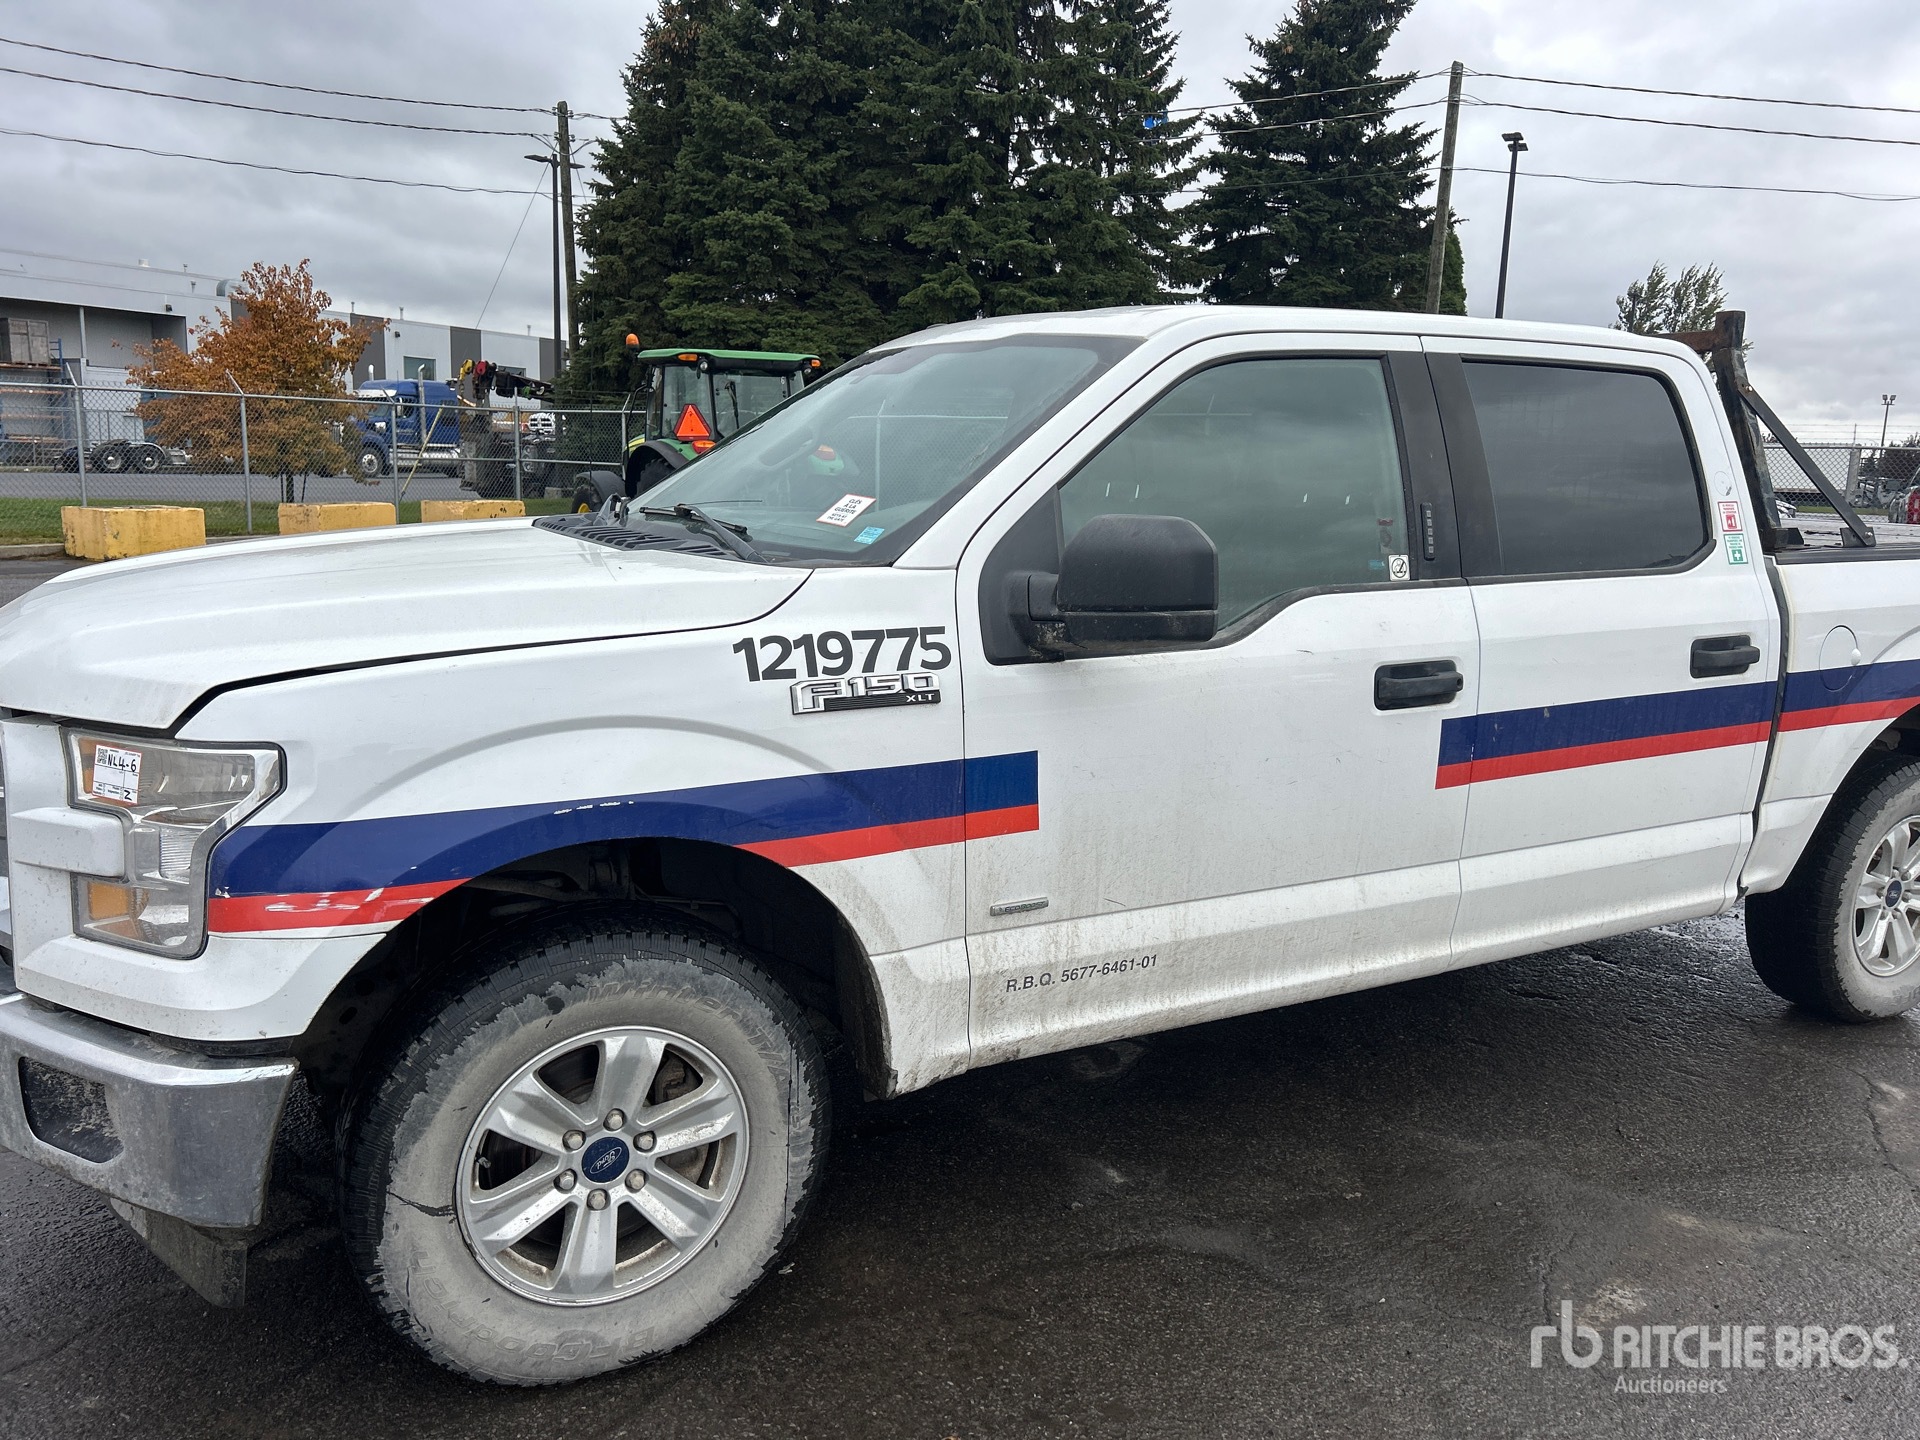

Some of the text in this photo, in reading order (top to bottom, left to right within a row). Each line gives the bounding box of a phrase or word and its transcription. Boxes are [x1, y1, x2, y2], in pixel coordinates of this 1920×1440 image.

[732, 625, 952, 682] 1219775
[906, 693, 935, 703] XLT
[1006, 954, 1158, 993] R.B.Q. 5677-6461-01
